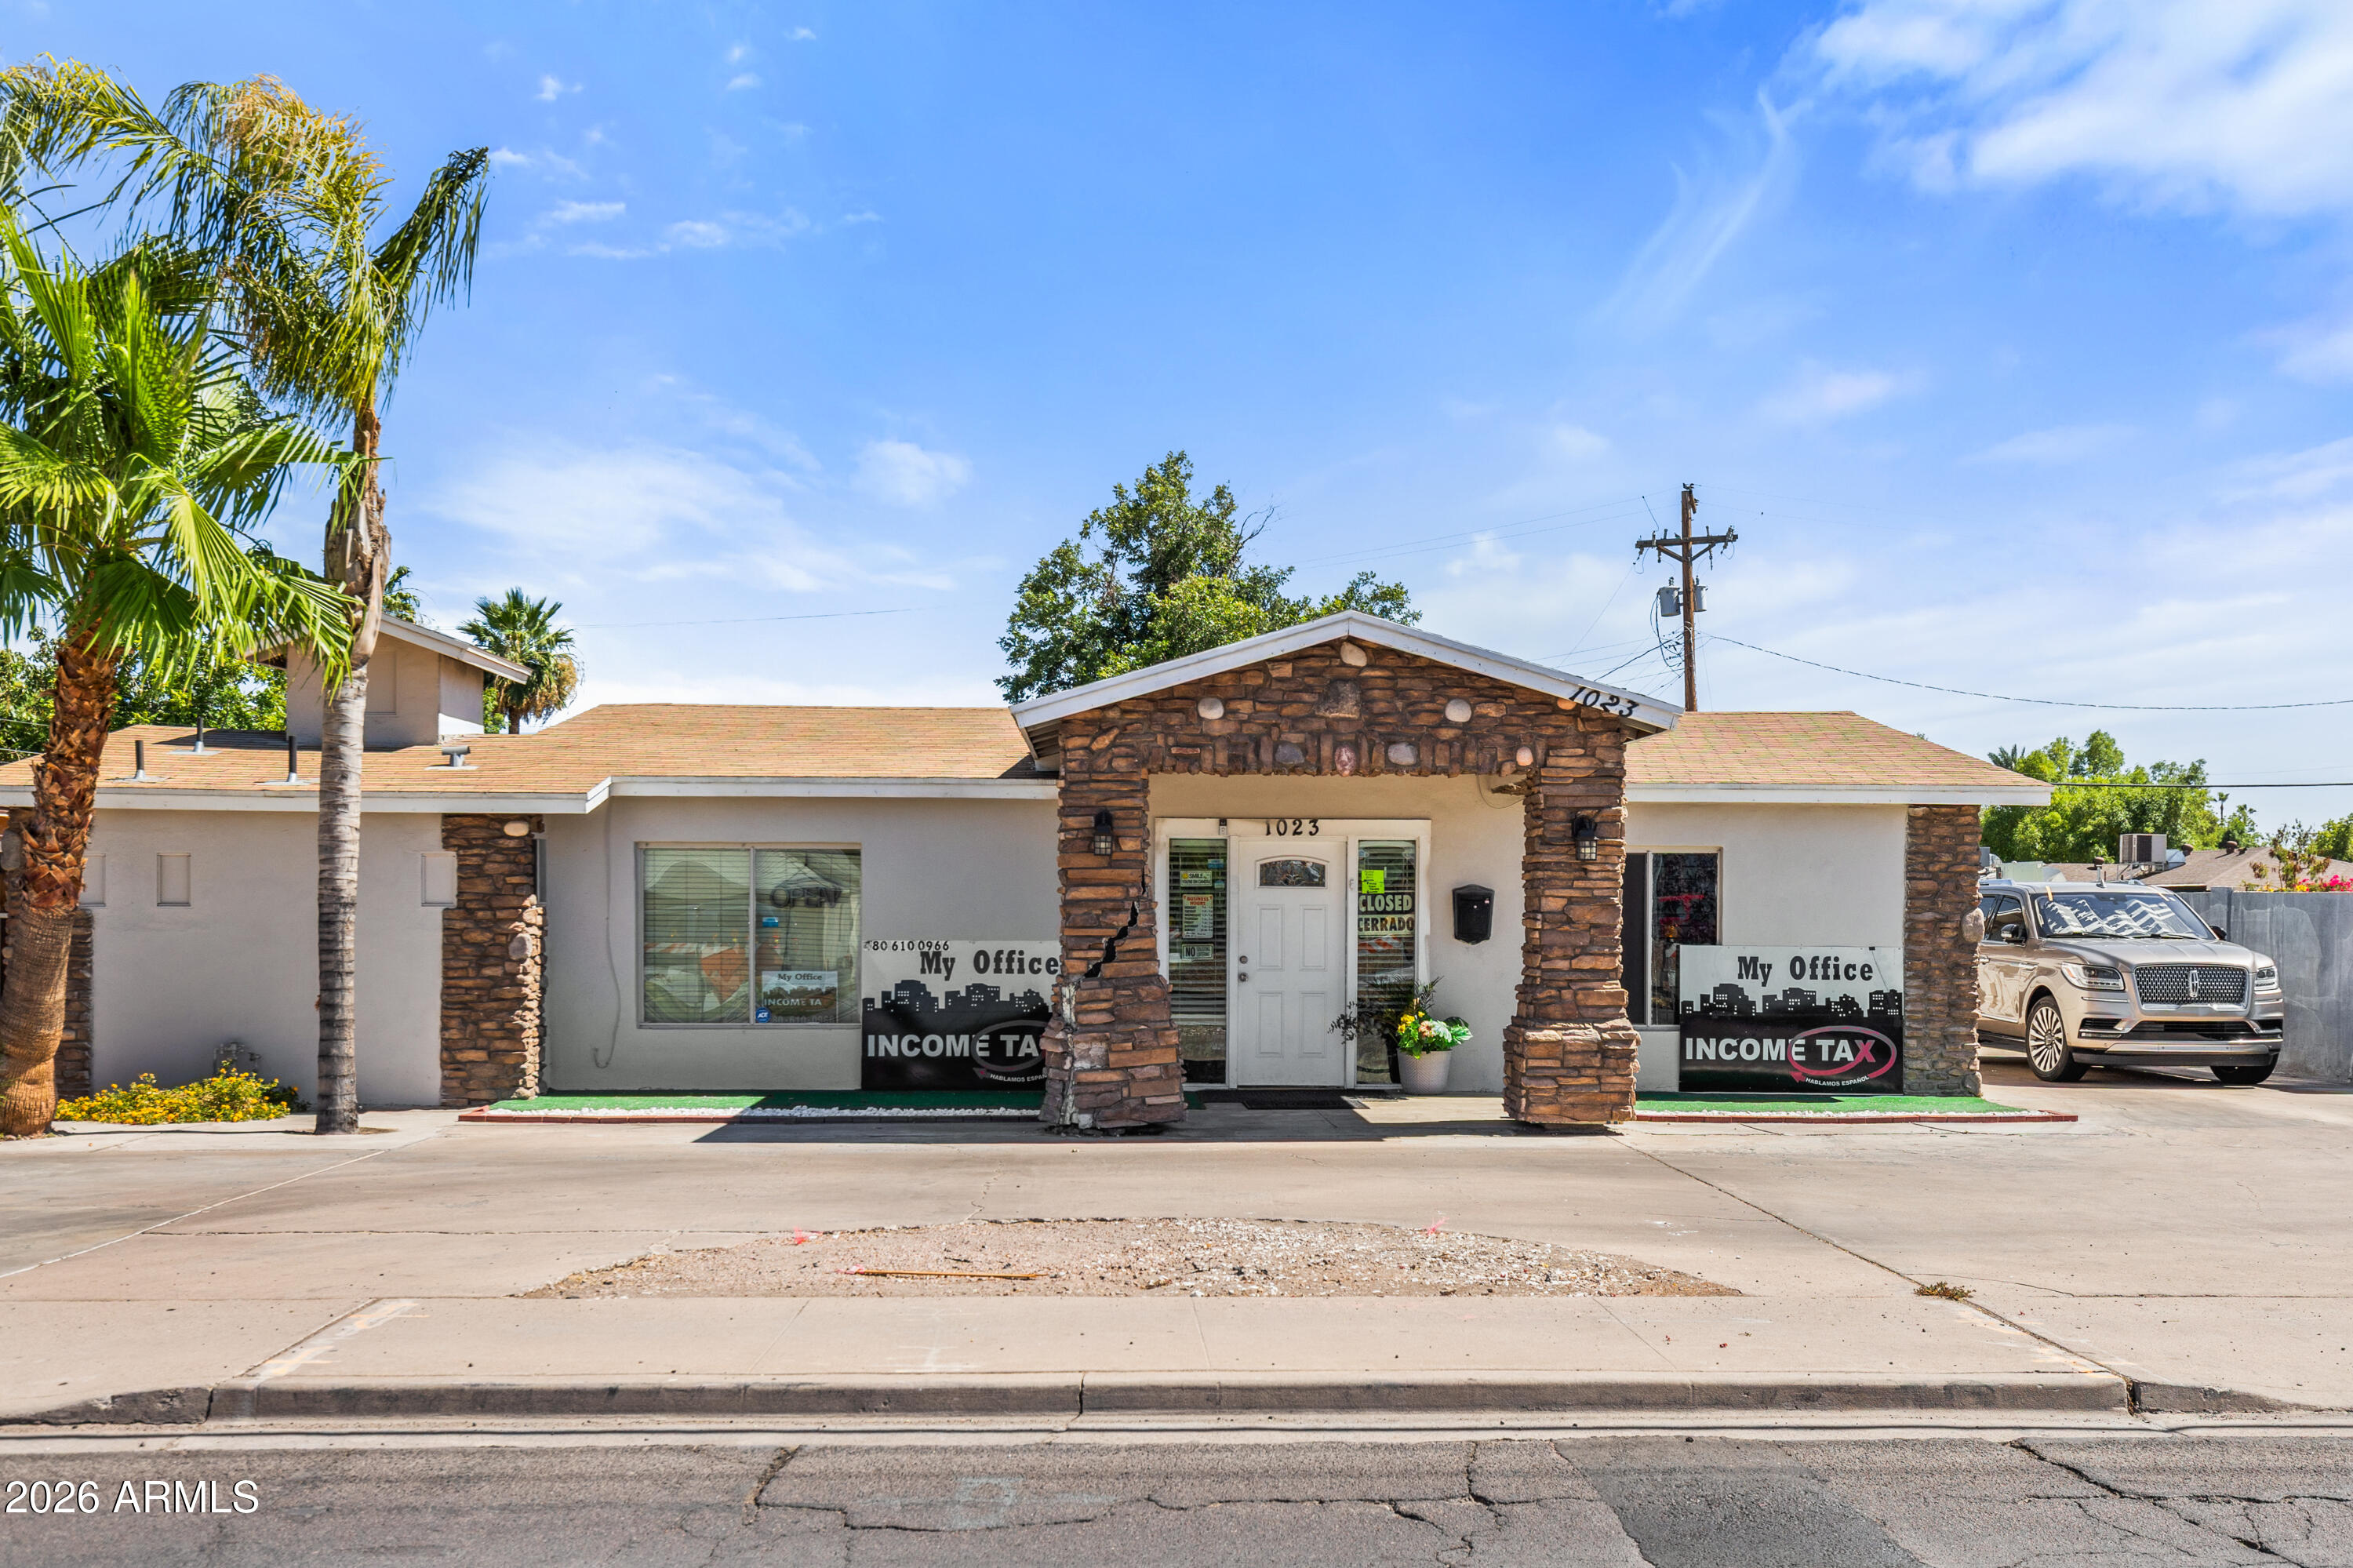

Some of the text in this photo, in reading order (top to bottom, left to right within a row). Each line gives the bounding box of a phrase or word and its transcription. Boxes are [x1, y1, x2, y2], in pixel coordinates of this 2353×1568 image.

[1569, 686, 1639, 718] 1023
[1265, 818, 1319, 836] 1023
[1358, 894, 1413, 912] CLOSED
[1358, 916, 1415, 932] CERRADO
[892, 941, 915, 951] 610
[918, 940, 949, 951] 0966
[1186, 947, 1195, 957] NO
[920, 950, 1059, 980] My Office
[1737, 955, 1874, 987] My Office
[777, 973, 791, 982] My
[764, 998, 806, 1006] INCOME
[867, 1034, 1046, 1057] INCOME TA
[1686, 1037, 1875, 1063] INCOME TAX
[990, 1073, 1025, 1082] HABLAMOS
[1806, 1077, 1840, 1086] HABLAMOS
